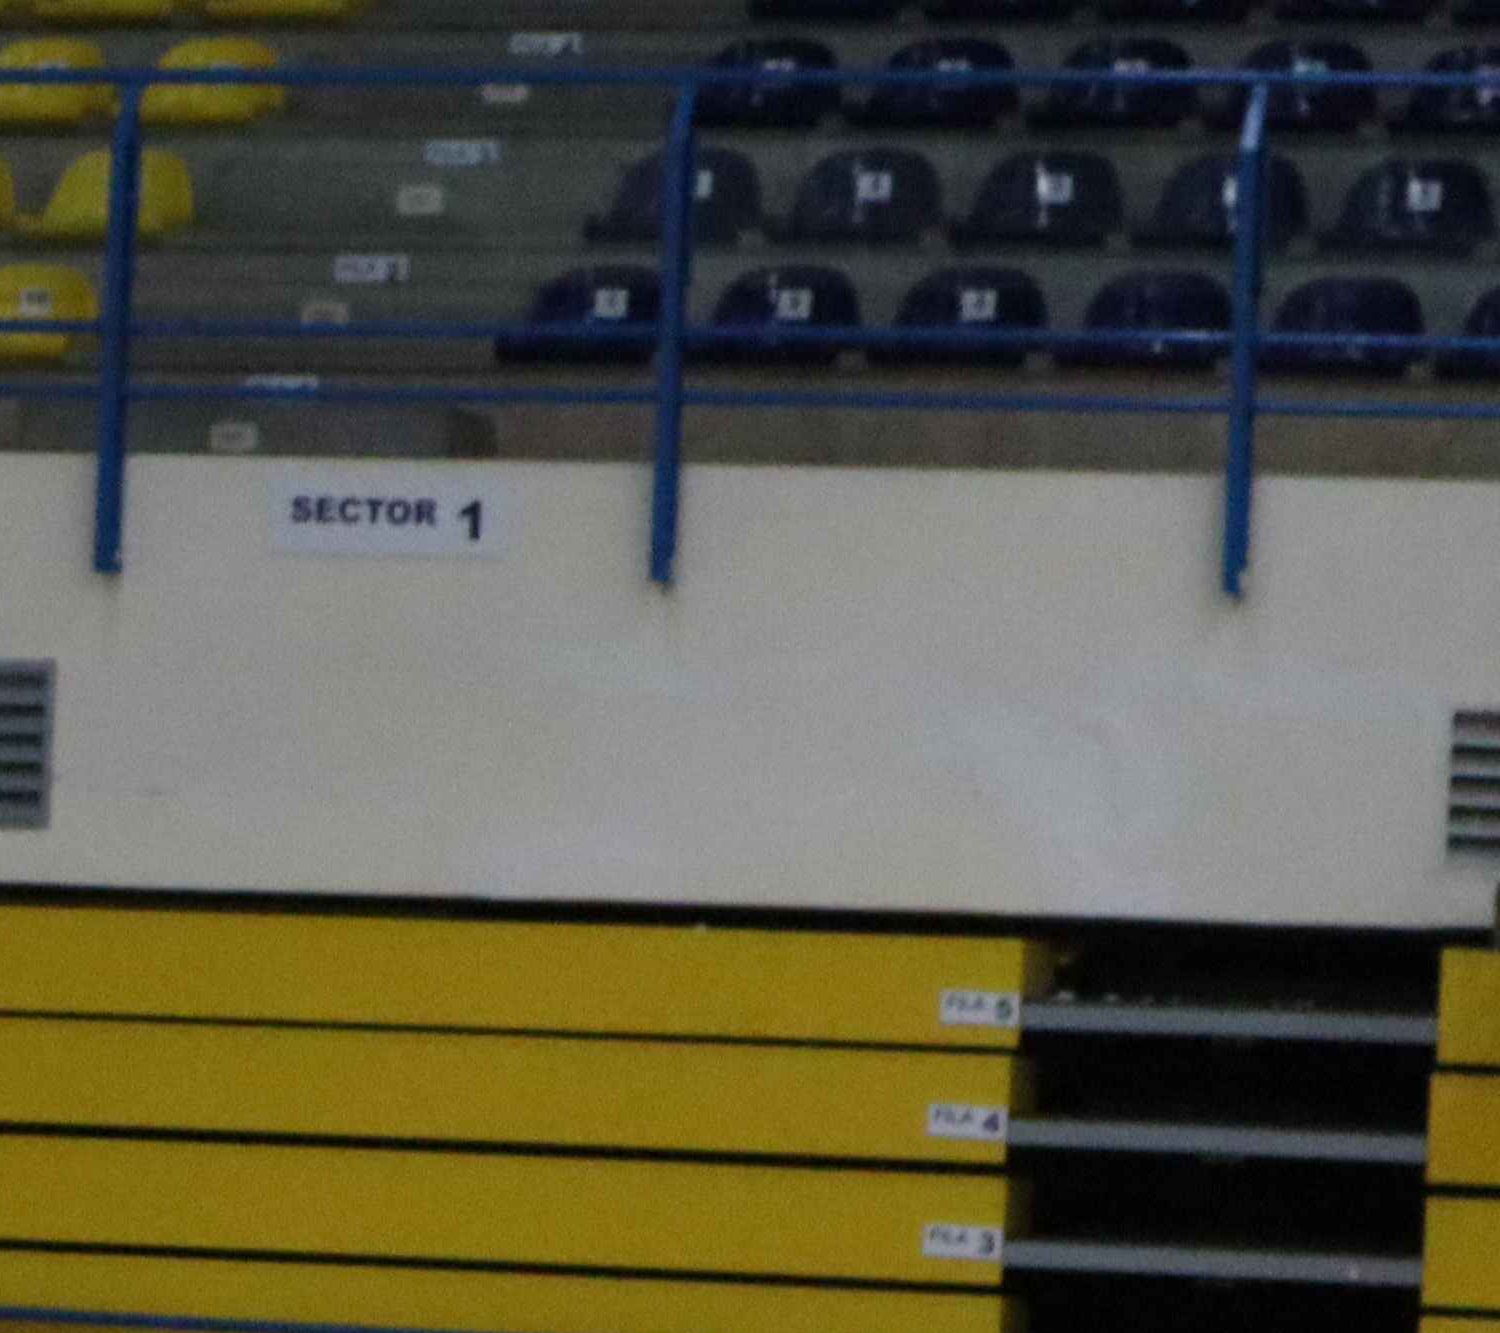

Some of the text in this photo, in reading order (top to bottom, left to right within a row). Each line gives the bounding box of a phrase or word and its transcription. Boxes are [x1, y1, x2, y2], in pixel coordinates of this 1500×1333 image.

[293, 496, 482, 541] SECTOR 1
[982, 1112, 1000, 1134] 4
